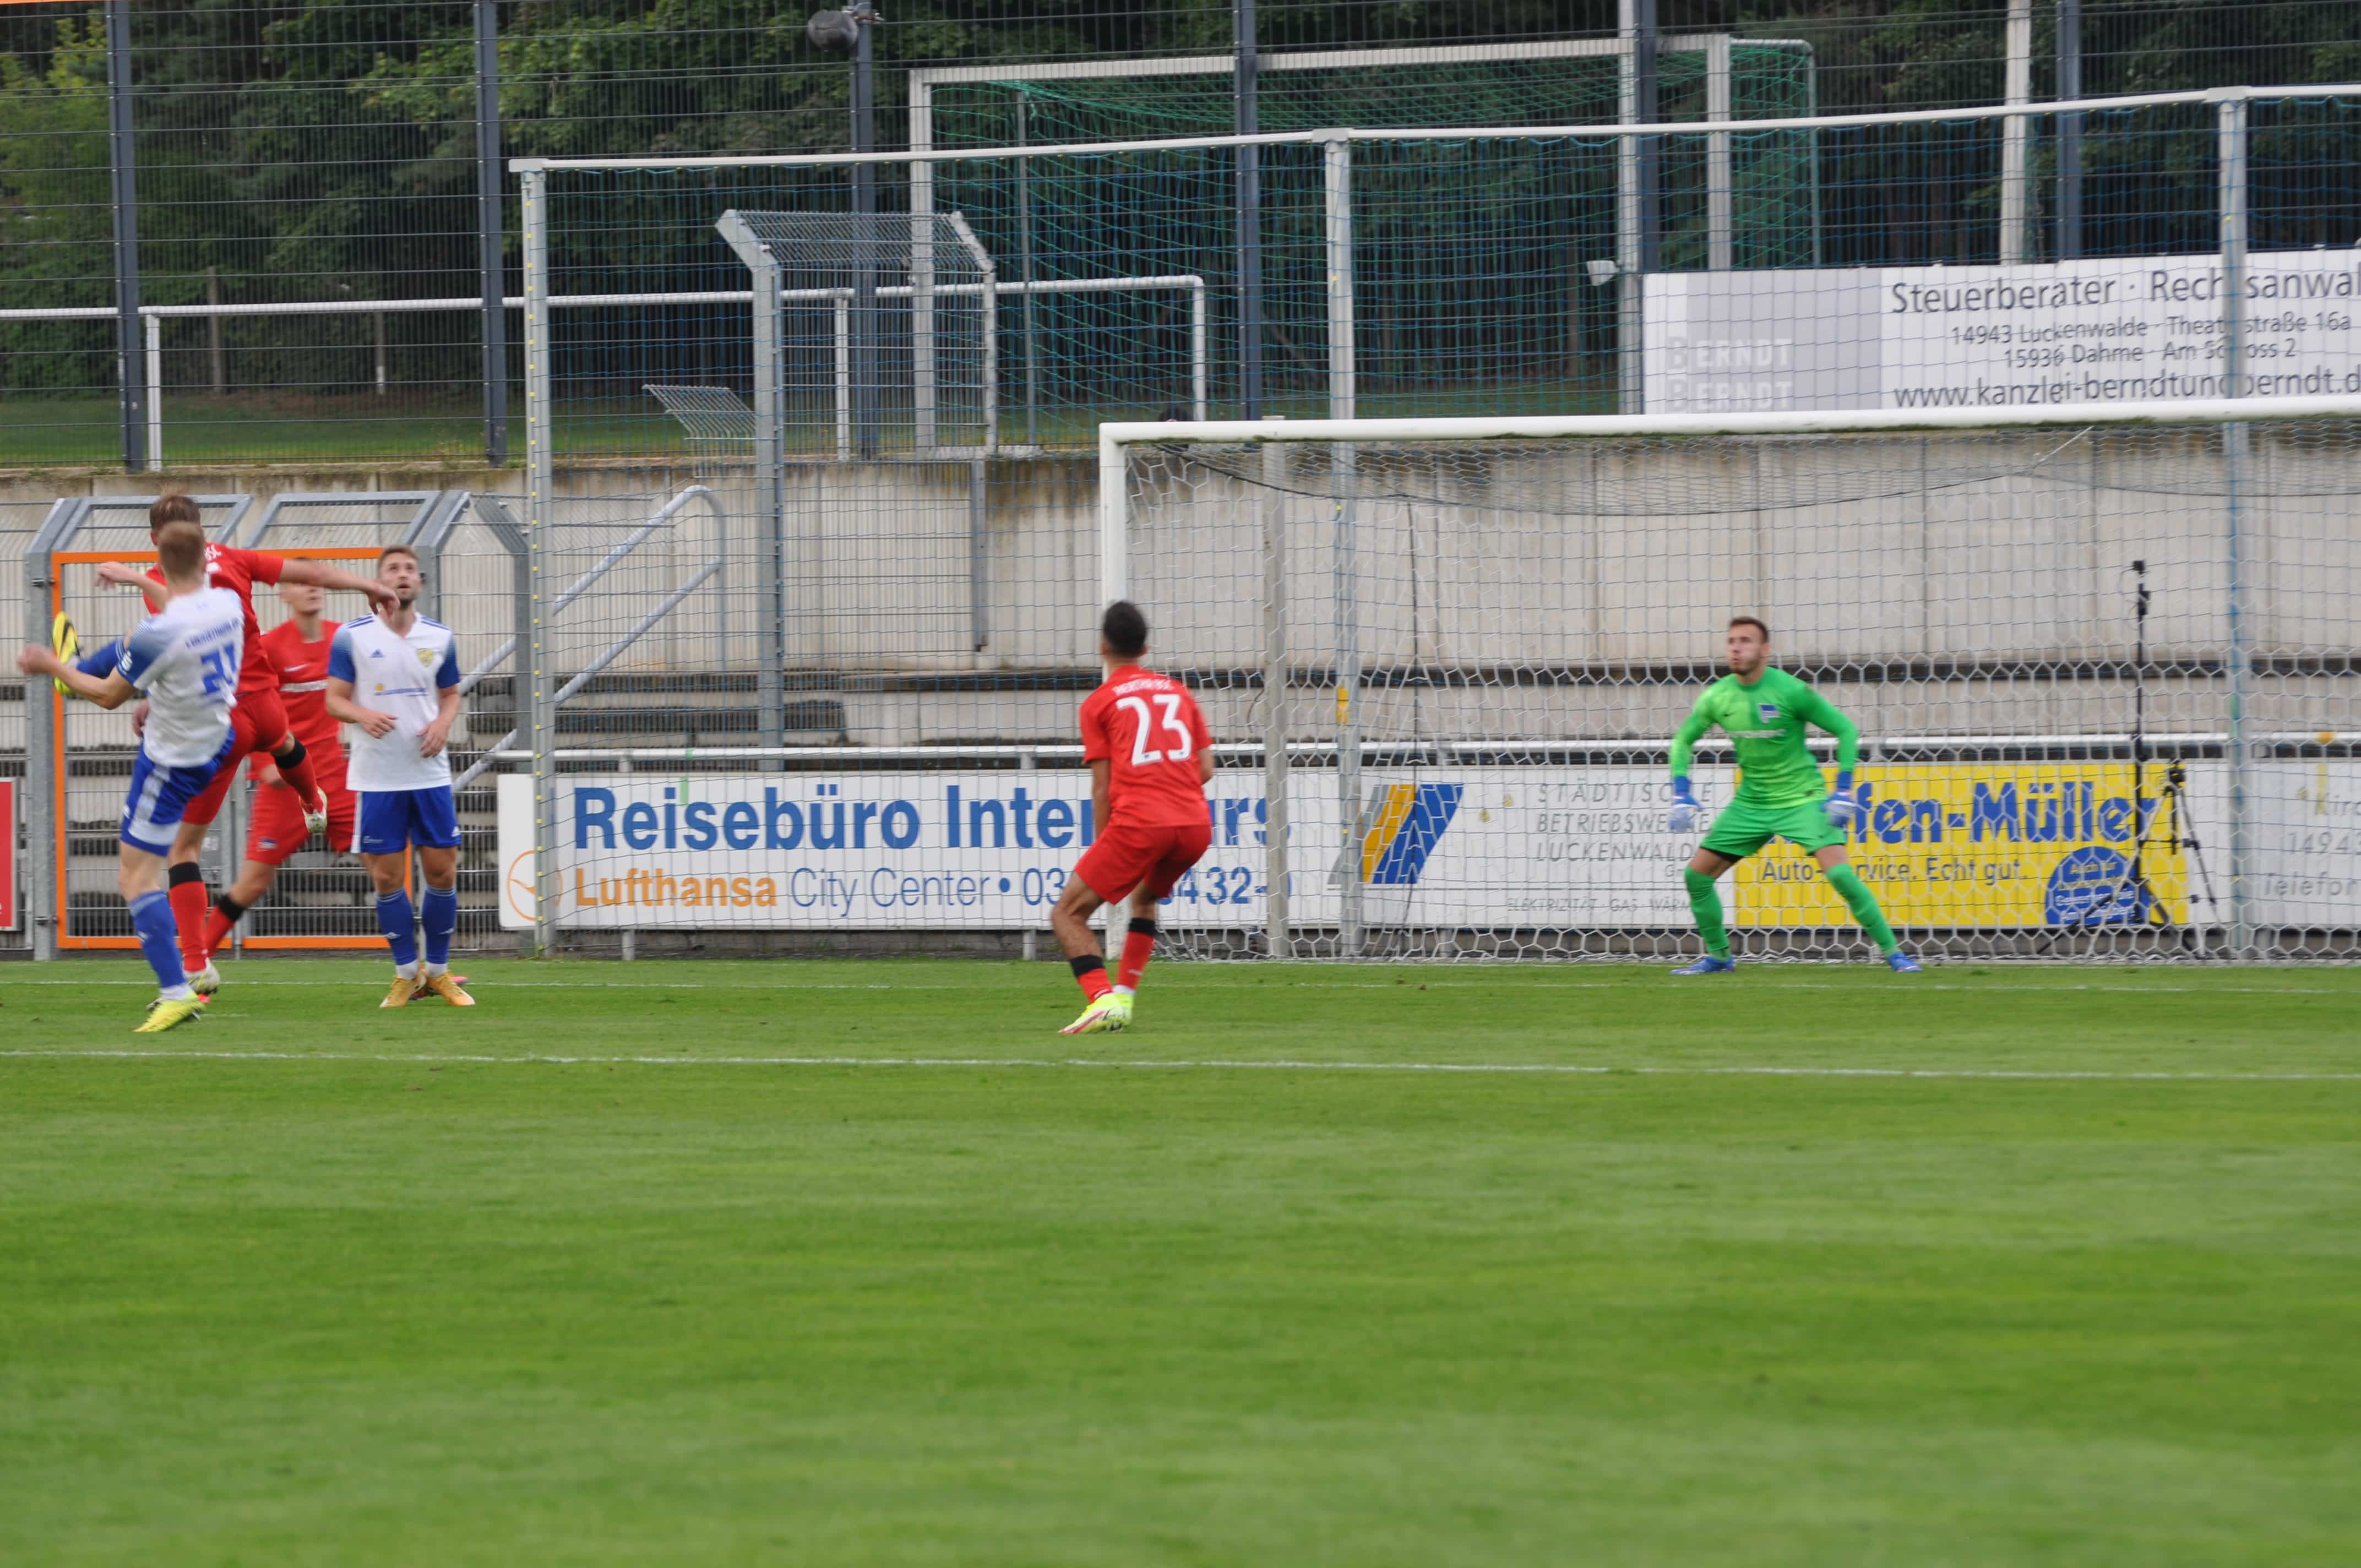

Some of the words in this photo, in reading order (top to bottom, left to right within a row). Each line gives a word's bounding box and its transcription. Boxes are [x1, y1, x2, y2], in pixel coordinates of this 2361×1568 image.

[1892, 276, 2116, 313] Steuerberater
[2150, 262, 2361, 302] Rechsanwal
[1952, 325, 2011, 345] 14943
[2020, 315, 2147, 344] Luckenwalde
[2316, 311, 2351, 331] 16a
[2072, 342, 2142, 363] Dahme
[2162, 341, 2196, 361] Am
[2285, 338, 2296, 358] 2
[1116, 694, 1193, 767] 23
[1538, 778, 1713, 802] STÄDTISCE
[574, 783, 920, 850] Reisebüro
[576, 868, 777, 907] Lufthansa
[791, 867, 858, 917] City
[871, 867, 990, 907] Center
[1927, 857, 1974, 880] Echt
[1984, 858, 2028, 885] gut.
